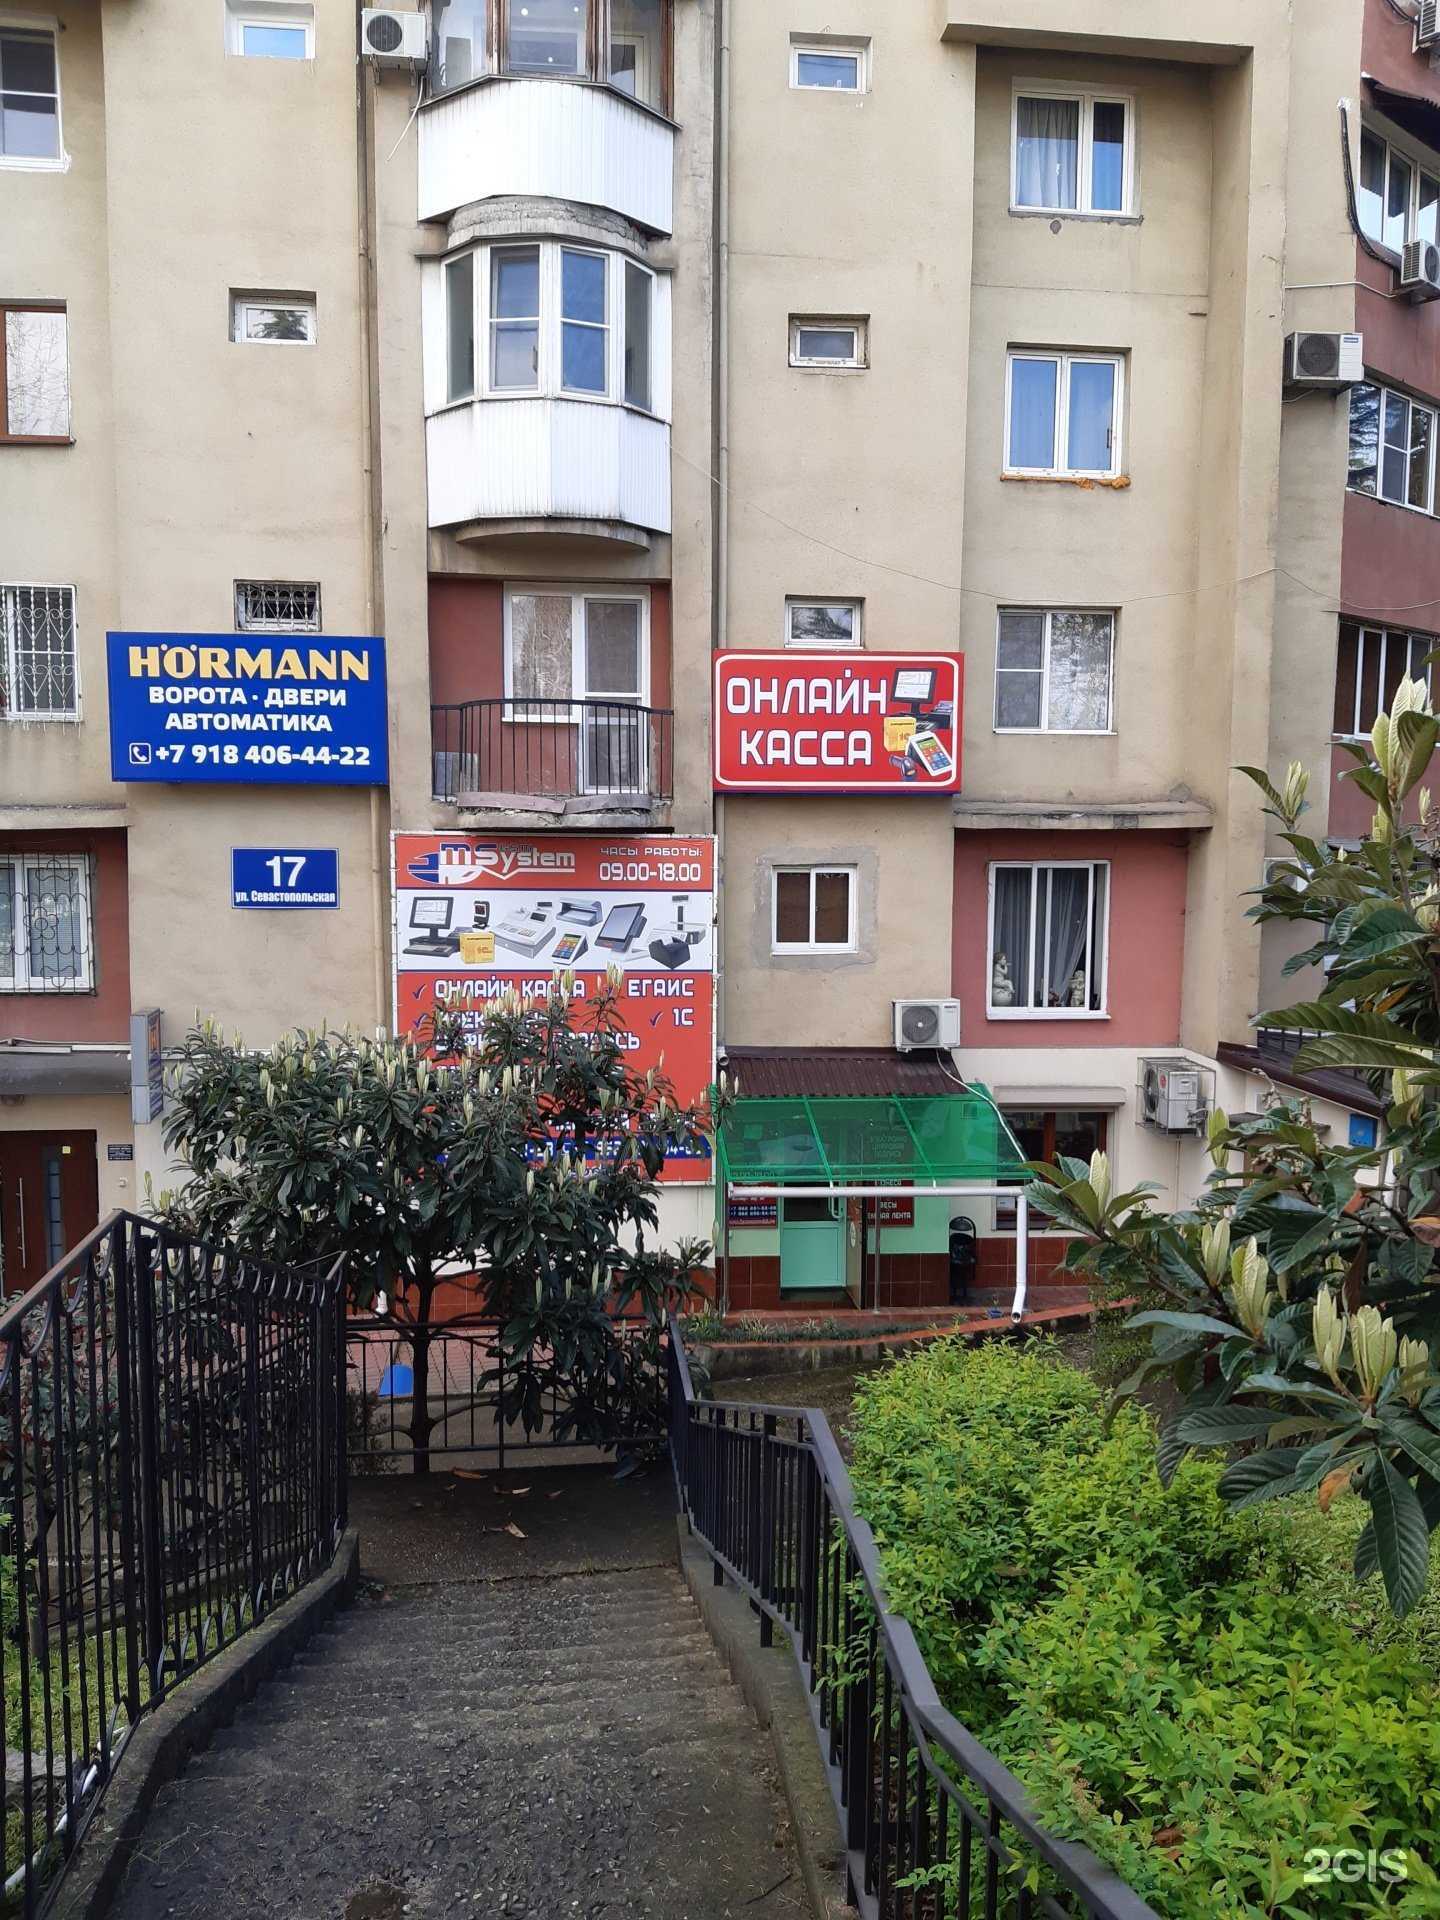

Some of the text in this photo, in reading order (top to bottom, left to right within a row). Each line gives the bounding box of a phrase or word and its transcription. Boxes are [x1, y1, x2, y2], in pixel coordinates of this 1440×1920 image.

[128, 643, 370, 681] HÖRMANN
[149, 686, 347, 708] ВОРОТА ДВЕРИ
[726, 668, 888, 715] ОНЛАЙН
[165, 712, 333, 732] АВТОМАТИКА
[155, 744, 370, 766] +7 918 406-44-22
[740, 729, 872, 766] КАССА
[600, 847, 703, 857] ЧАСЫ РАБОТЫ:
[265, 855, 307, 887] 17
[599, 862, 701, 881] 09.00-18.00
[235, 890, 336, 903] ул. Севастопольская
[628, 978, 694, 997] ЕГАИС
[672, 1008, 694, 1026] 1С
